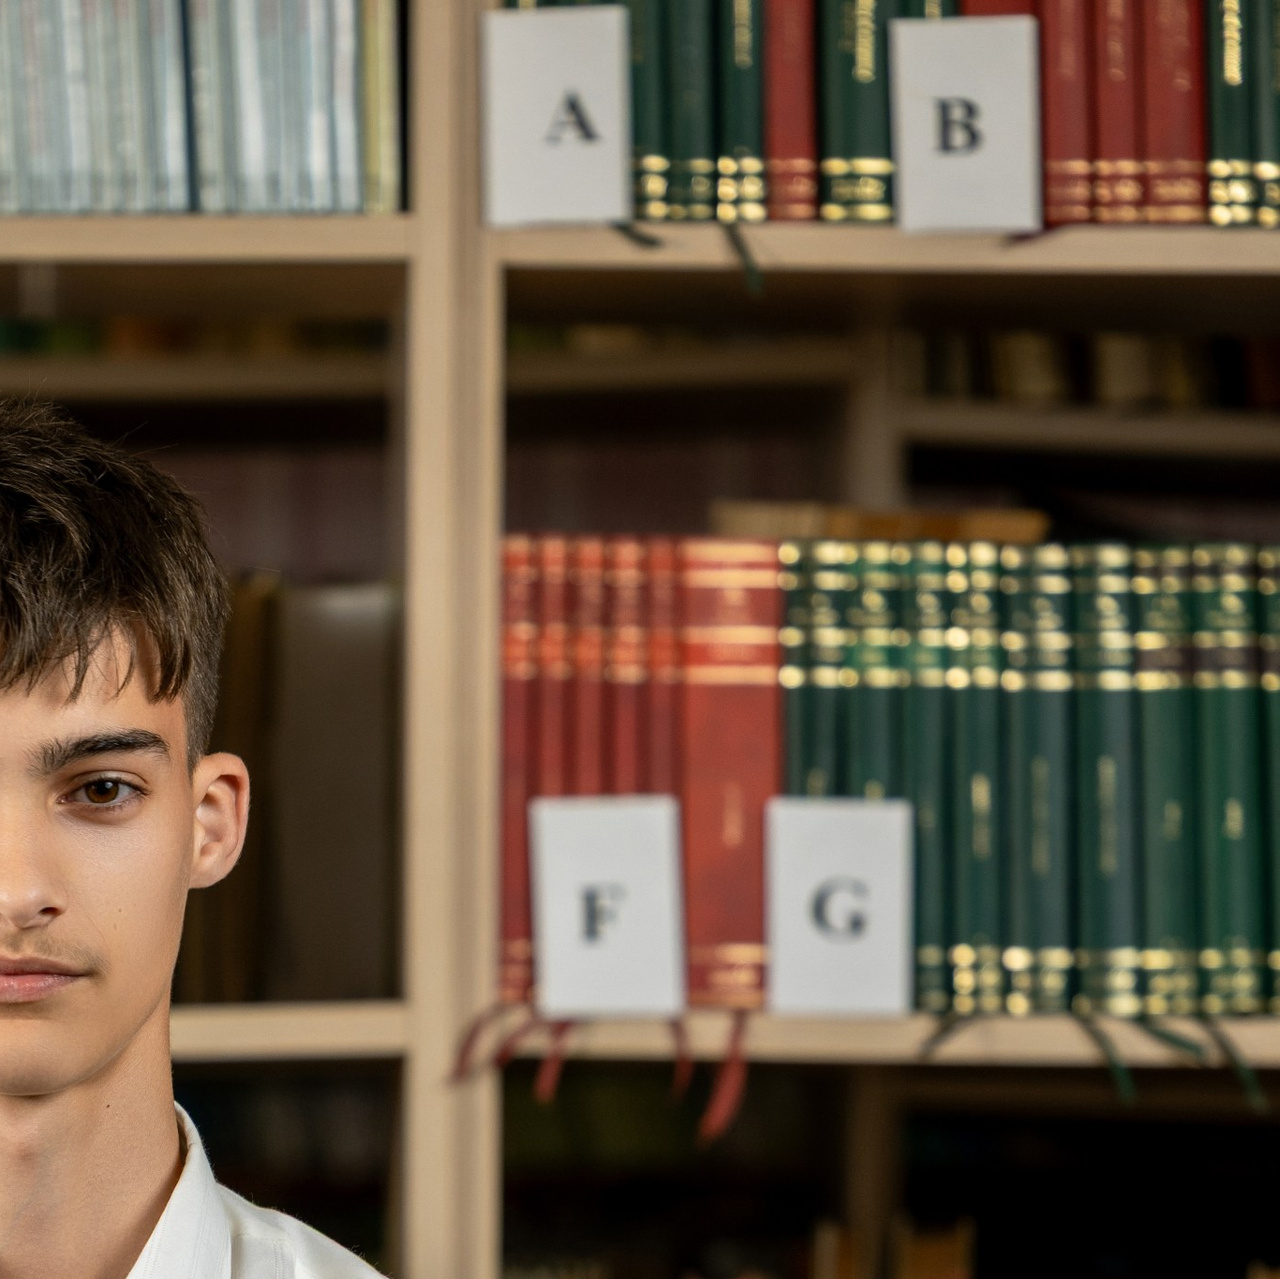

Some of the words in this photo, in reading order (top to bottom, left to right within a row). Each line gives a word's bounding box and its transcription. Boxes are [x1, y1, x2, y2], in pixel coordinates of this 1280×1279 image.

[546, 90, 601, 146] A
[933, 96, 984, 156] B
[578, 882, 626, 947] F
[807, 880, 870, 942] G
